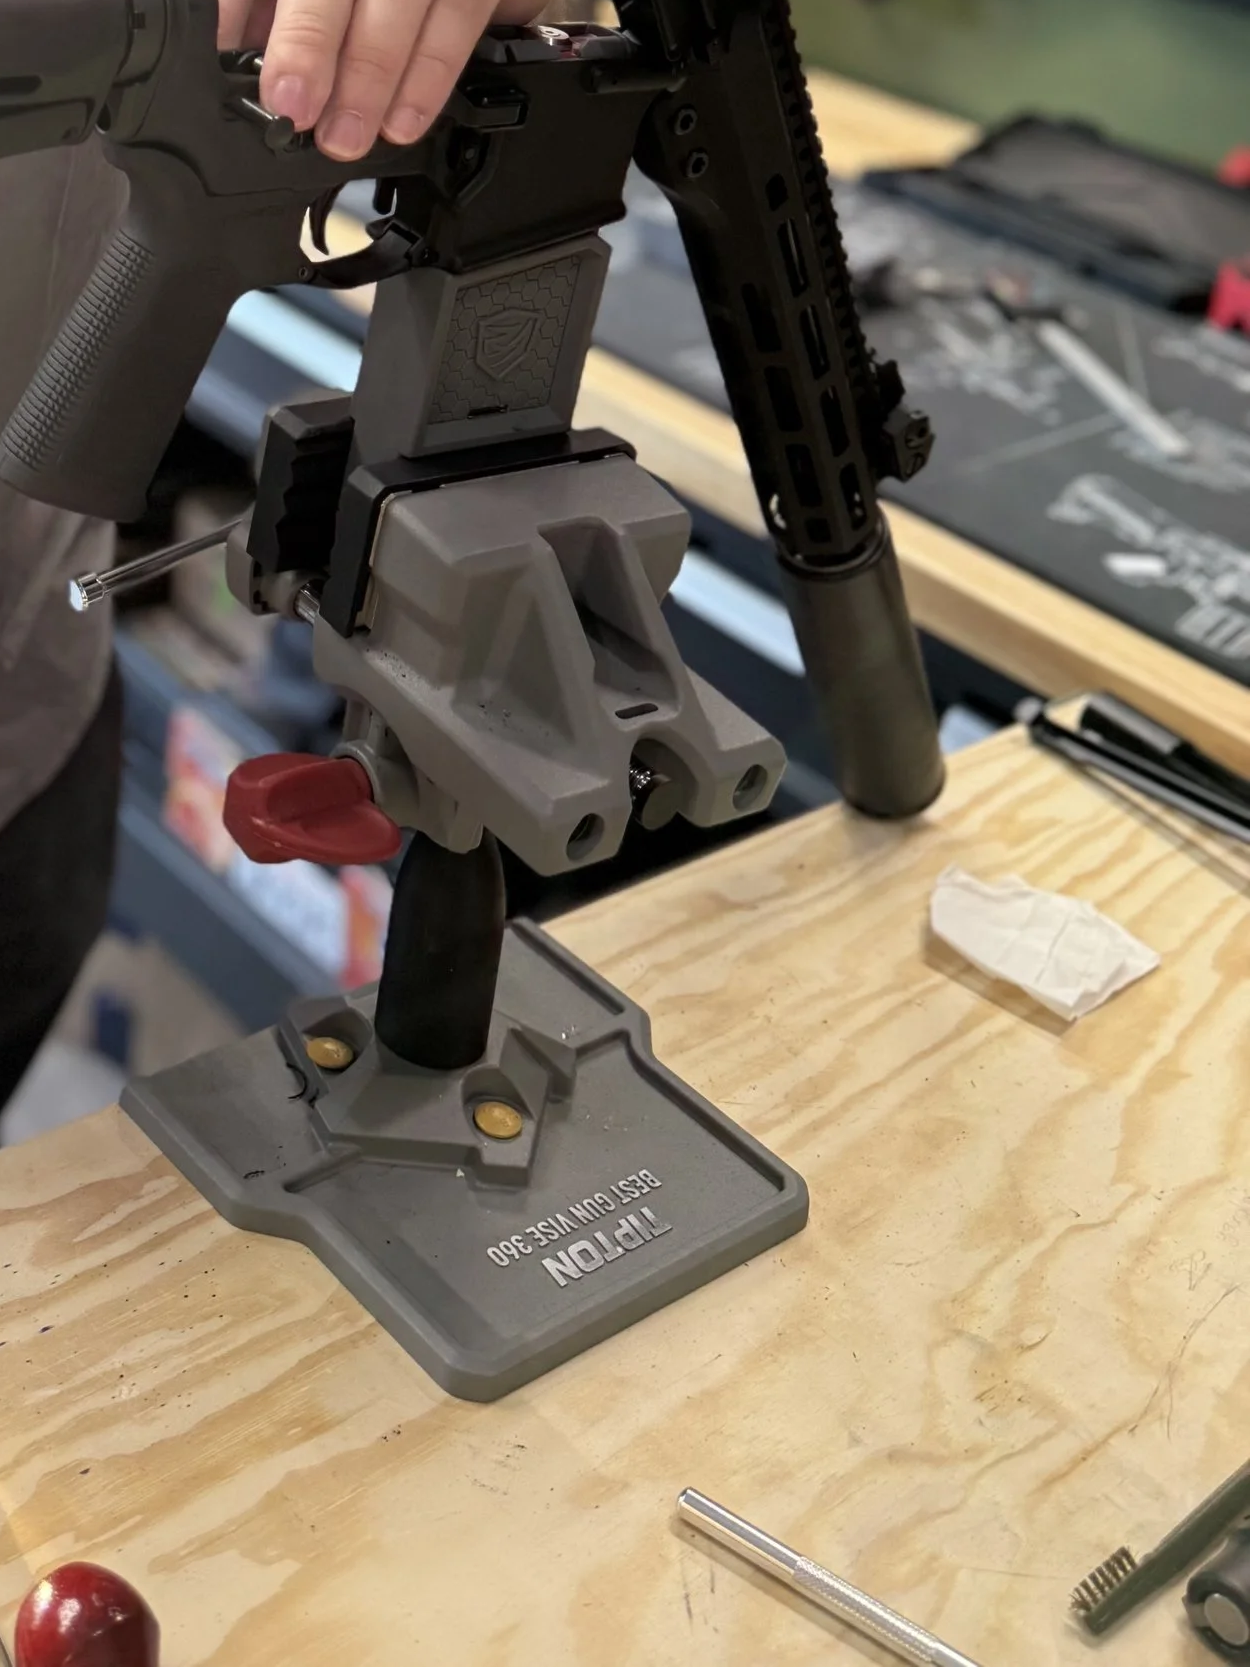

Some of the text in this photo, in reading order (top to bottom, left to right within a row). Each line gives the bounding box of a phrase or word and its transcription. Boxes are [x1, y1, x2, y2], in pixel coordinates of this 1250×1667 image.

[487, 1168, 662, 1267] BEST GUN VISE 360
[541, 1206, 673, 1287] TIPTON
